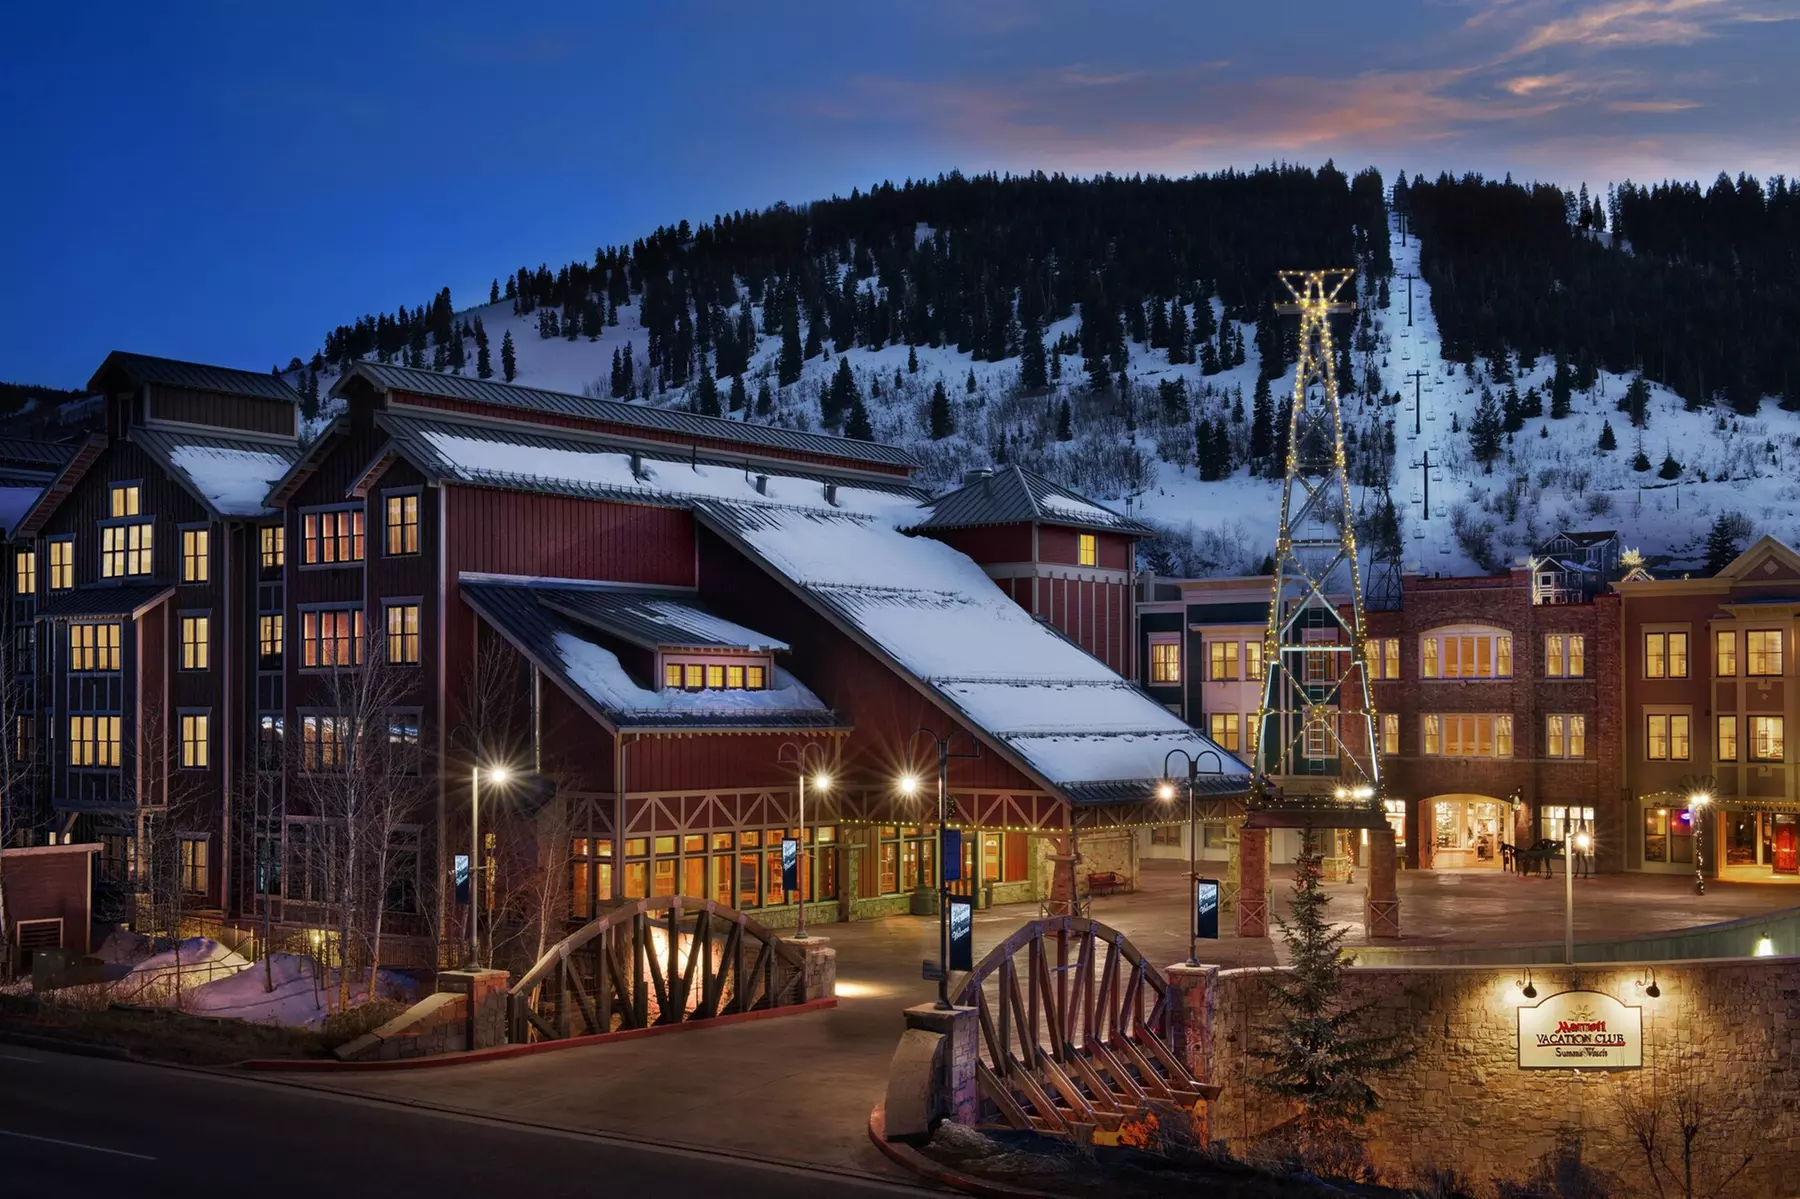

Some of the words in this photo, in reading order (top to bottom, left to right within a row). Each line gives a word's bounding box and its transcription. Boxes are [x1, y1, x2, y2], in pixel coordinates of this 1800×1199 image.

[1555, 1020, 1606, 1033] Marriott
[1536, 1034, 1592, 1044] VACATION
[1595, 1034, 1624, 1044] CLUB
